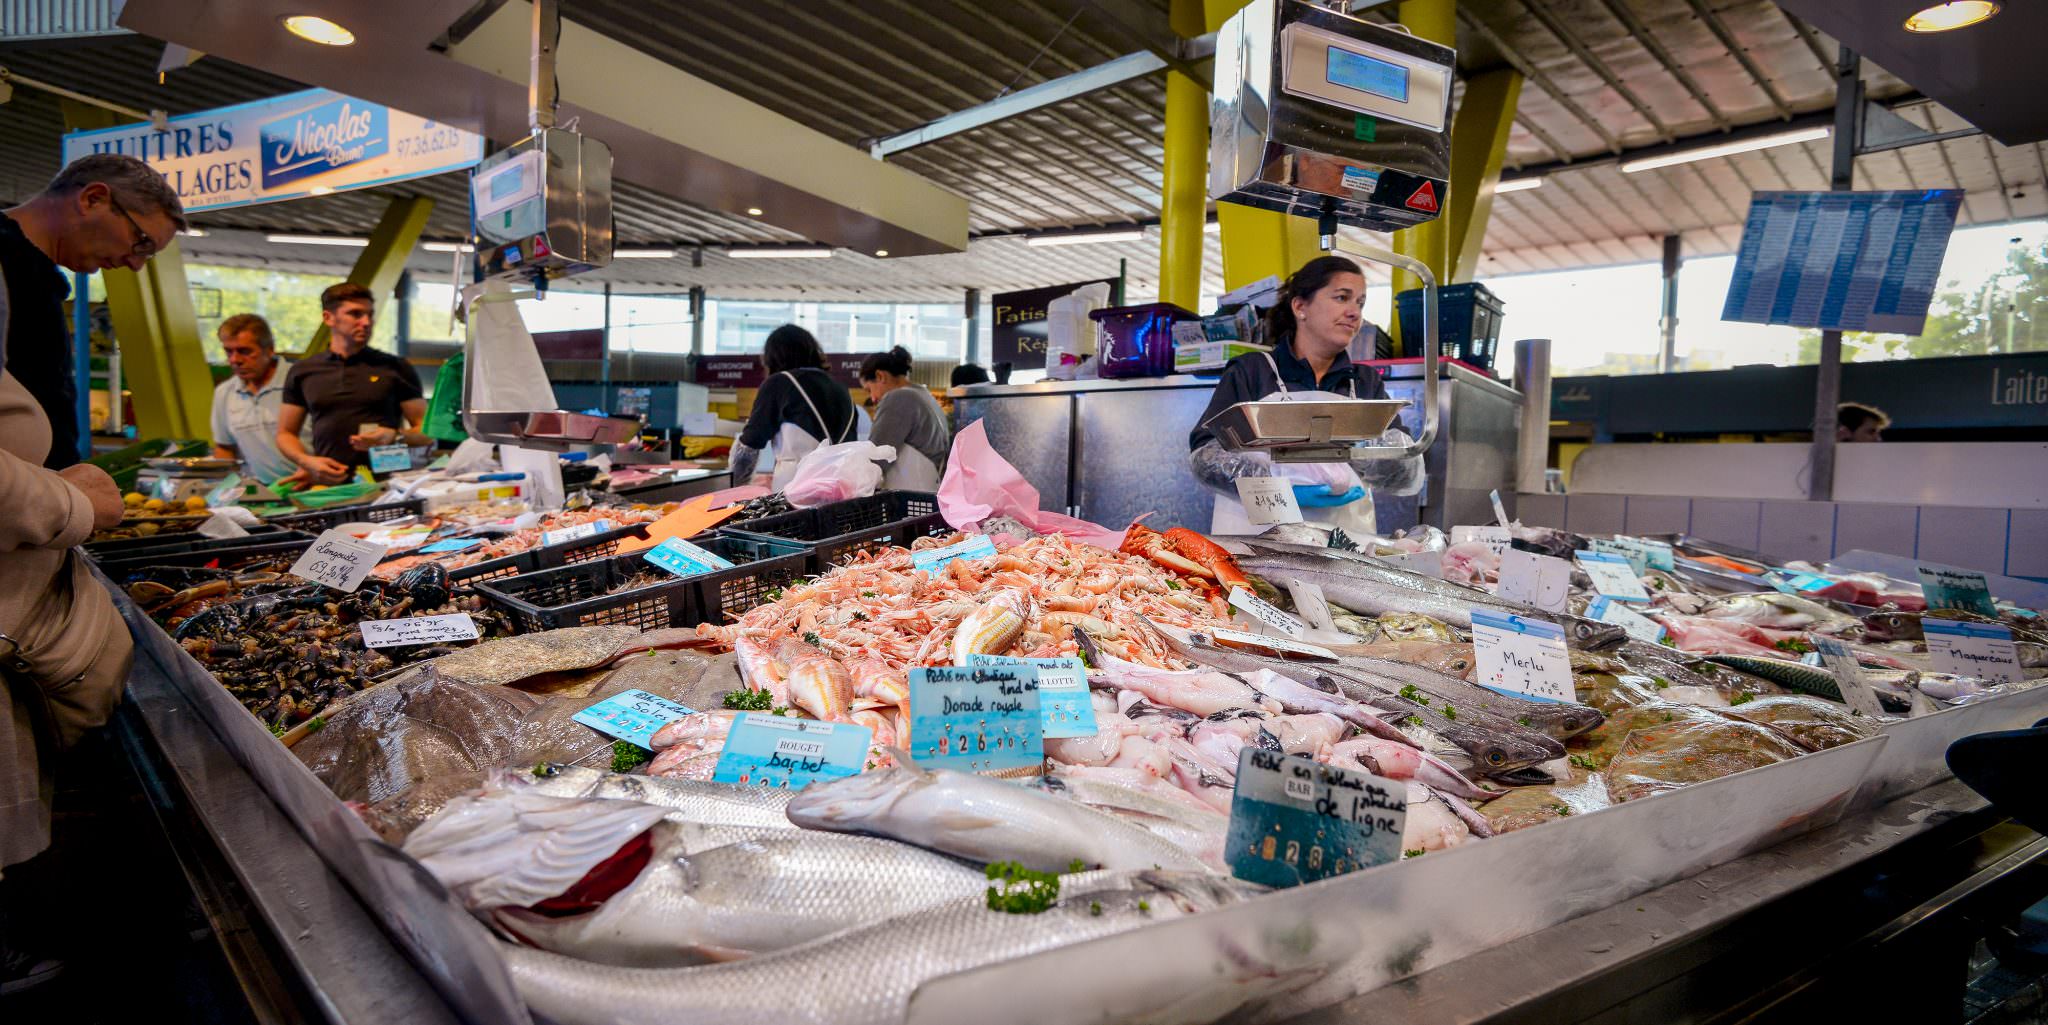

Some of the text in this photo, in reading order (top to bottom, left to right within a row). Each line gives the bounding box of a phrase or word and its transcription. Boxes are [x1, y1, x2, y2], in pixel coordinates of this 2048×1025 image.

[276, 103, 371, 164] Nicolas
[707, 361, 753, 371] GASTRONOMIE
[717, 371, 742, 380] MARINE
[1503, 651, 1545, 672] Merlu
[1950, 649, 2014, 664] Maquereaux
[631, 702, 670, 721] Soles
[942, 695, 1024, 718] Dorade royale
[779, 739, 823, 753] ROUGET
[765, 751, 831, 773] barbet
[1286, 780, 1311, 796] BAR
[1316, 788, 1399, 838] de ligne
